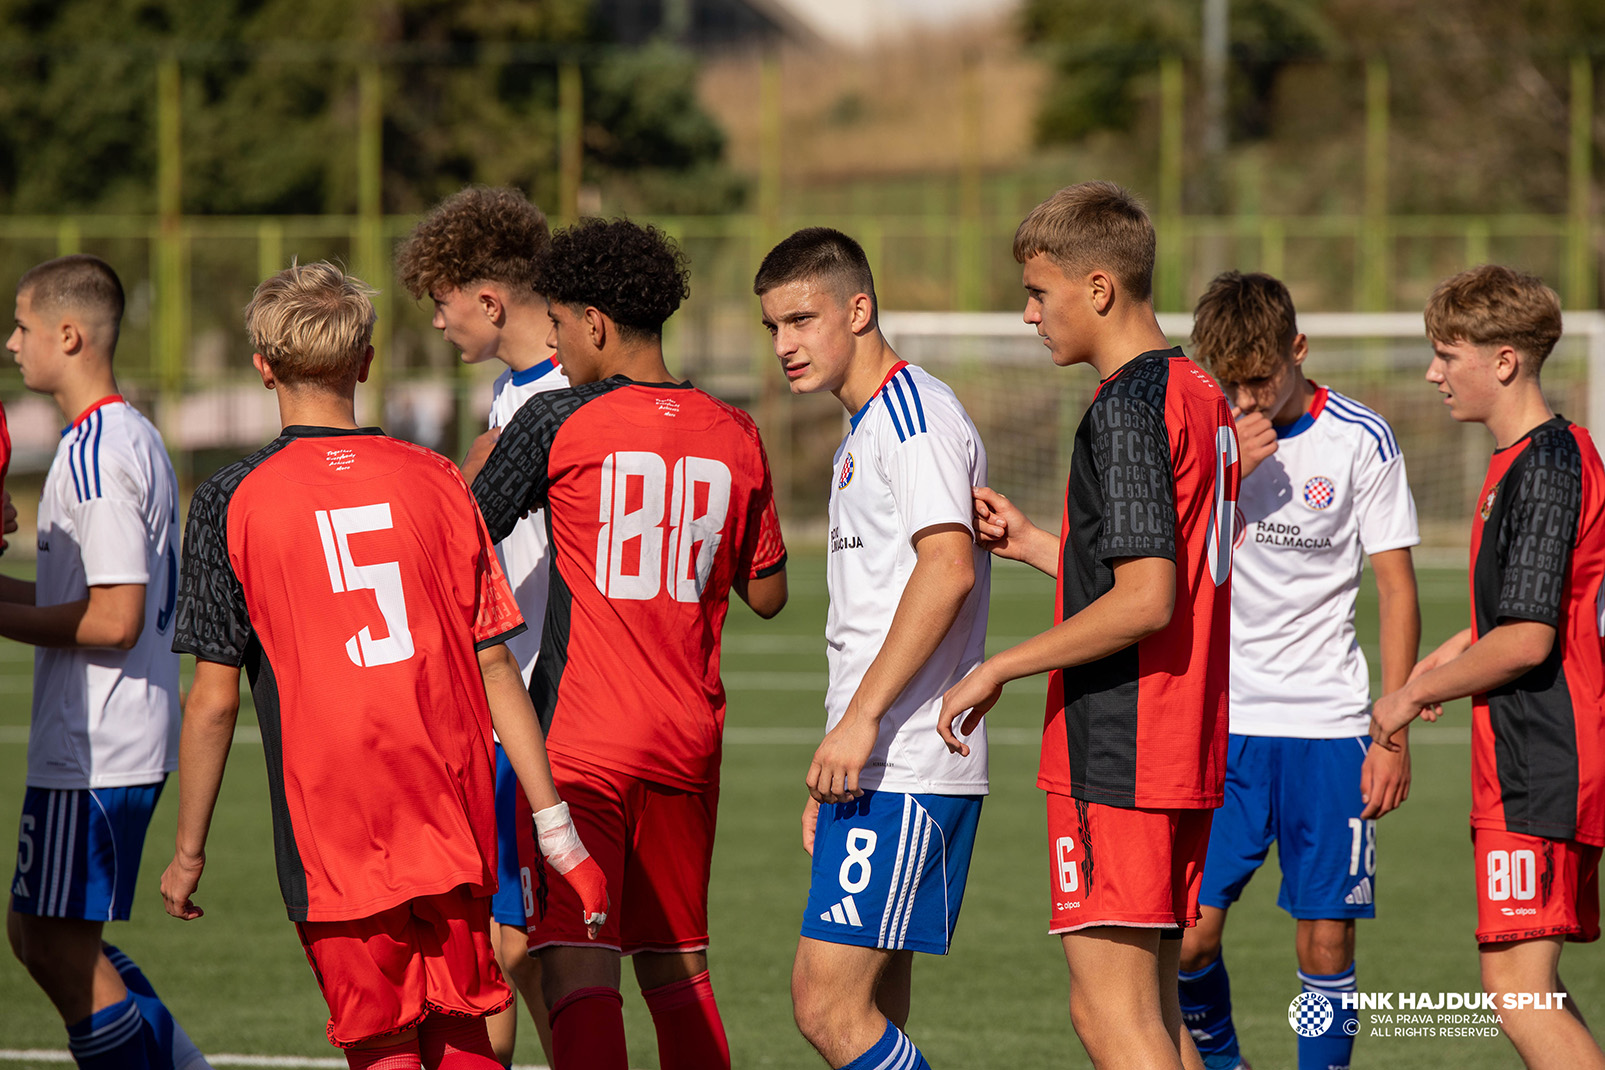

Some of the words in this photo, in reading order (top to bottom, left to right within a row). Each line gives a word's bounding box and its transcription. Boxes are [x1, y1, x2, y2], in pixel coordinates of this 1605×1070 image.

[1091, 397, 1121, 433] CG
[595, 451, 732, 603] 88
[1114, 501, 1162, 534] FCG
[1257, 521, 1300, 535] RADIO
[1255, 533, 1332, 548] DALMACIJA
[315, 503, 415, 667] 5
[839, 827, 877, 894] 8
[1348, 817, 1376, 876] 18
[1056, 836, 1079, 893] 6
[1487, 849, 1536, 901] 80
[1064, 901, 1081, 910] alpas
[1515, 907, 1536, 916] alpas
[1495, 932, 1519, 942] FCG
[1524, 928, 1546, 938] FCG
